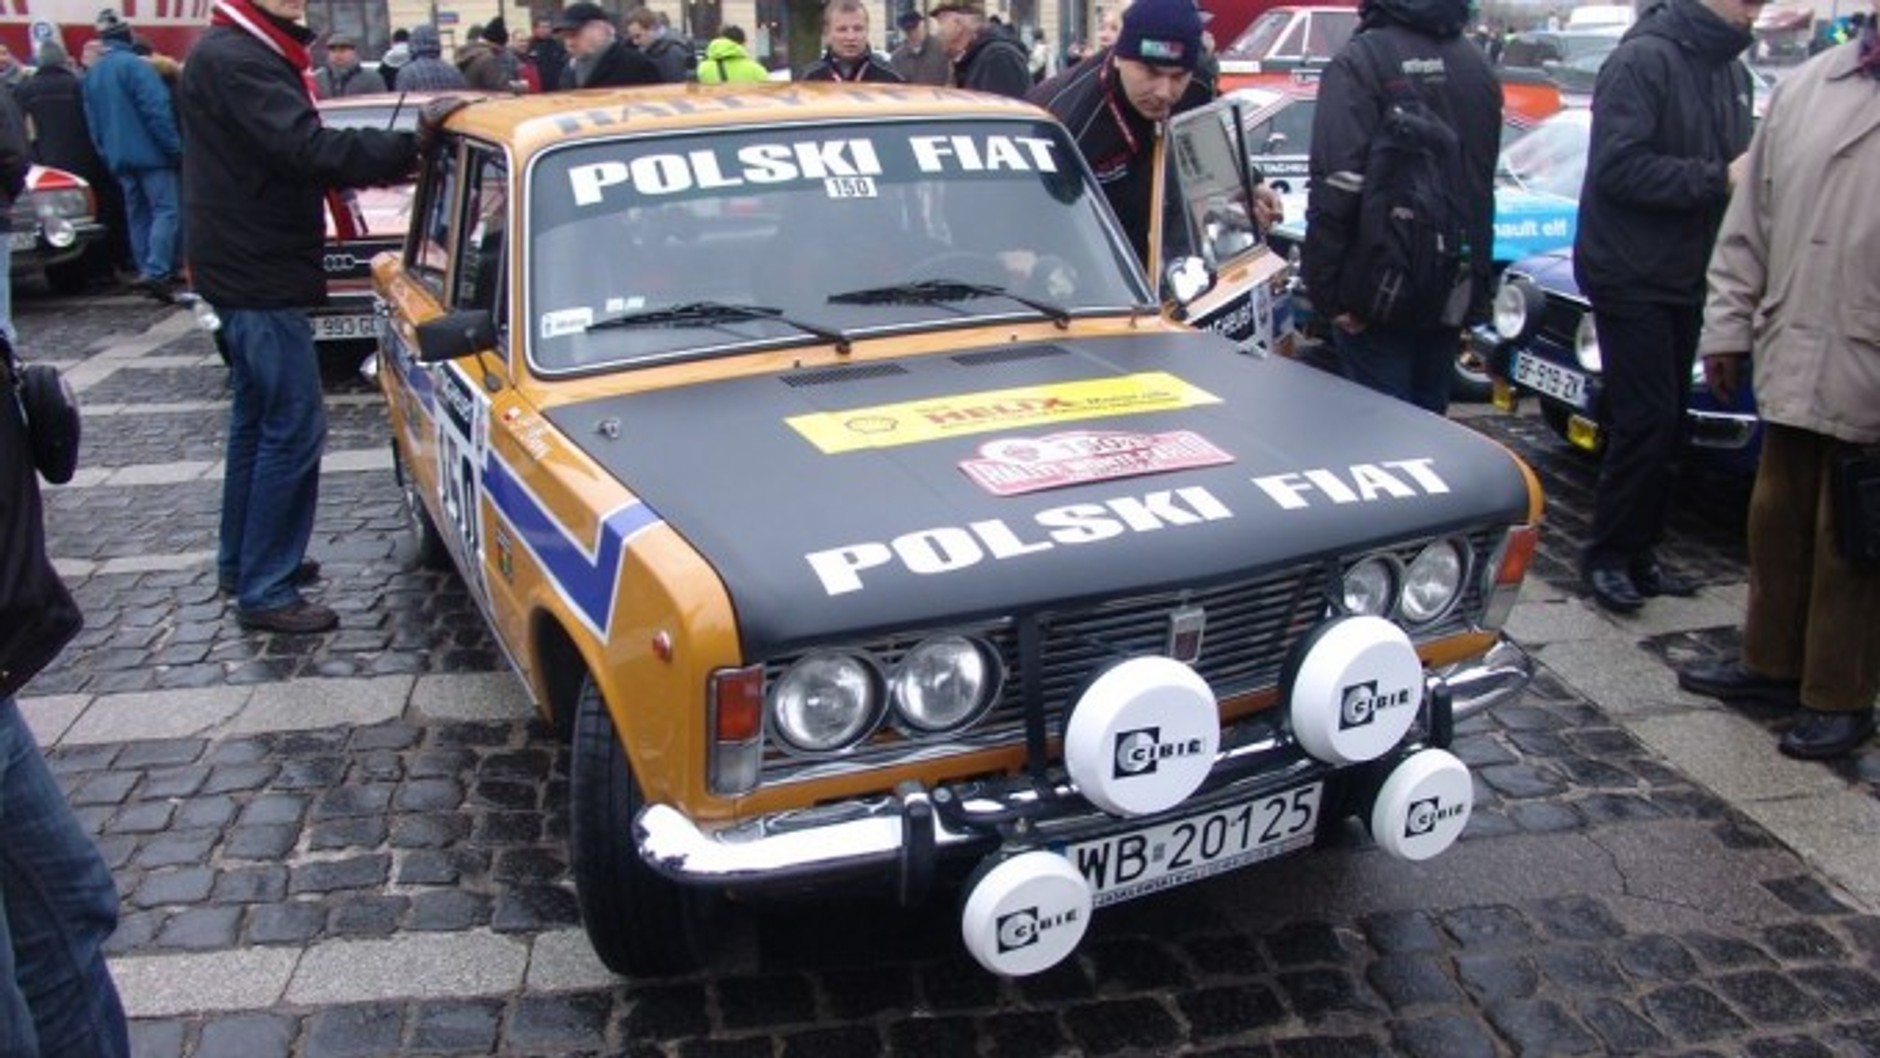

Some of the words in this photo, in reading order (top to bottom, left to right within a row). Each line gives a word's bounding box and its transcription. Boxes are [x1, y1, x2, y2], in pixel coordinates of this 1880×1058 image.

[568, 138, 883, 206] POLSKI
[909, 134, 1058, 172] FIAT
[832, 178, 869, 196] 150
[1493, 220, 1538, 237] nault
[923, 396, 1075, 426] HELIX
[805, 485, 1235, 596] POLSKI
[1251, 457, 1452, 510] FIAT
[1131, 739, 1199, 761] CIBIE
[1076, 834, 1148, 891] WB
[1166, 787, 1315, 871] 20125
